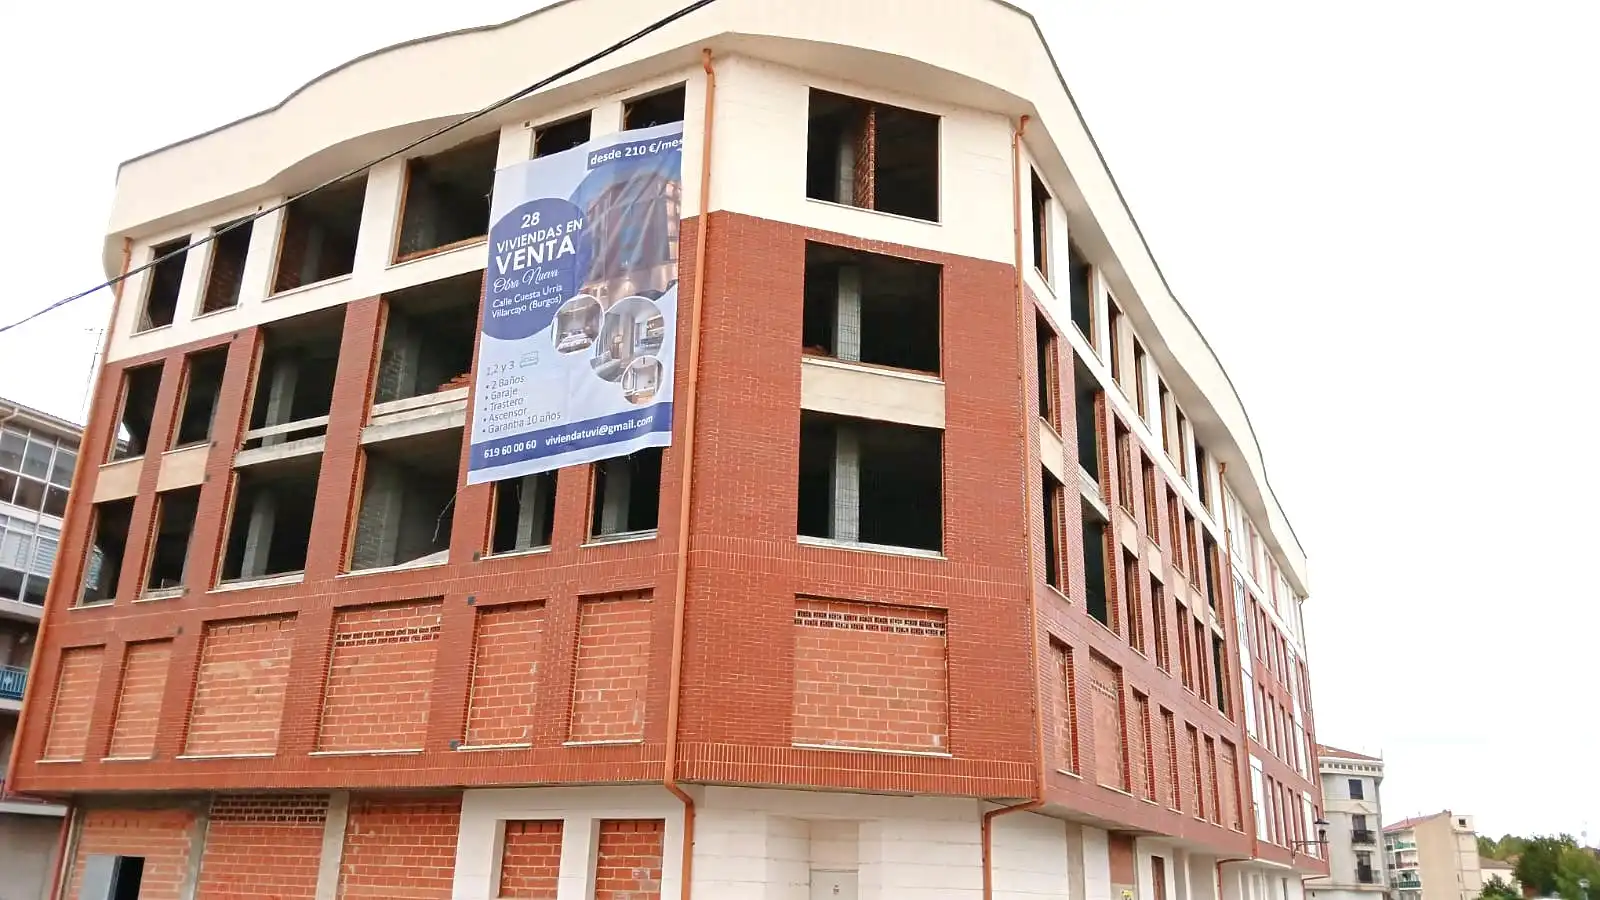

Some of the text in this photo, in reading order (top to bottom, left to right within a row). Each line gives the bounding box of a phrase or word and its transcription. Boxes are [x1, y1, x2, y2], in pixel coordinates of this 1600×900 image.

[590, 149, 622, 165] desde
[624, 145, 647, 157] 210
[521, 211, 541, 229] 28
[496, 218, 583, 254] VIVIENDAS EN
[496, 234, 576, 275] VENTA
[493, 266, 559, 294] Obra Nueva
[492, 283, 563, 308] Calle Cuesta Urria
[492, 293, 562, 318] Villarcayo (Burgos)
[501, 364, 507, 373] y
[509, 360, 515, 370] 3
[499, 375, 525, 387] Baños
[491, 386, 518, 400] Garaje
[489, 407, 527, 421] Ascensor
[490, 397, 524, 412] Trastero
[527, 414, 538, 426] 10
[540, 411, 561, 423] años
[484, 415, 653, 459] 619 60 00 60 viviendatuvi@gmail.com
